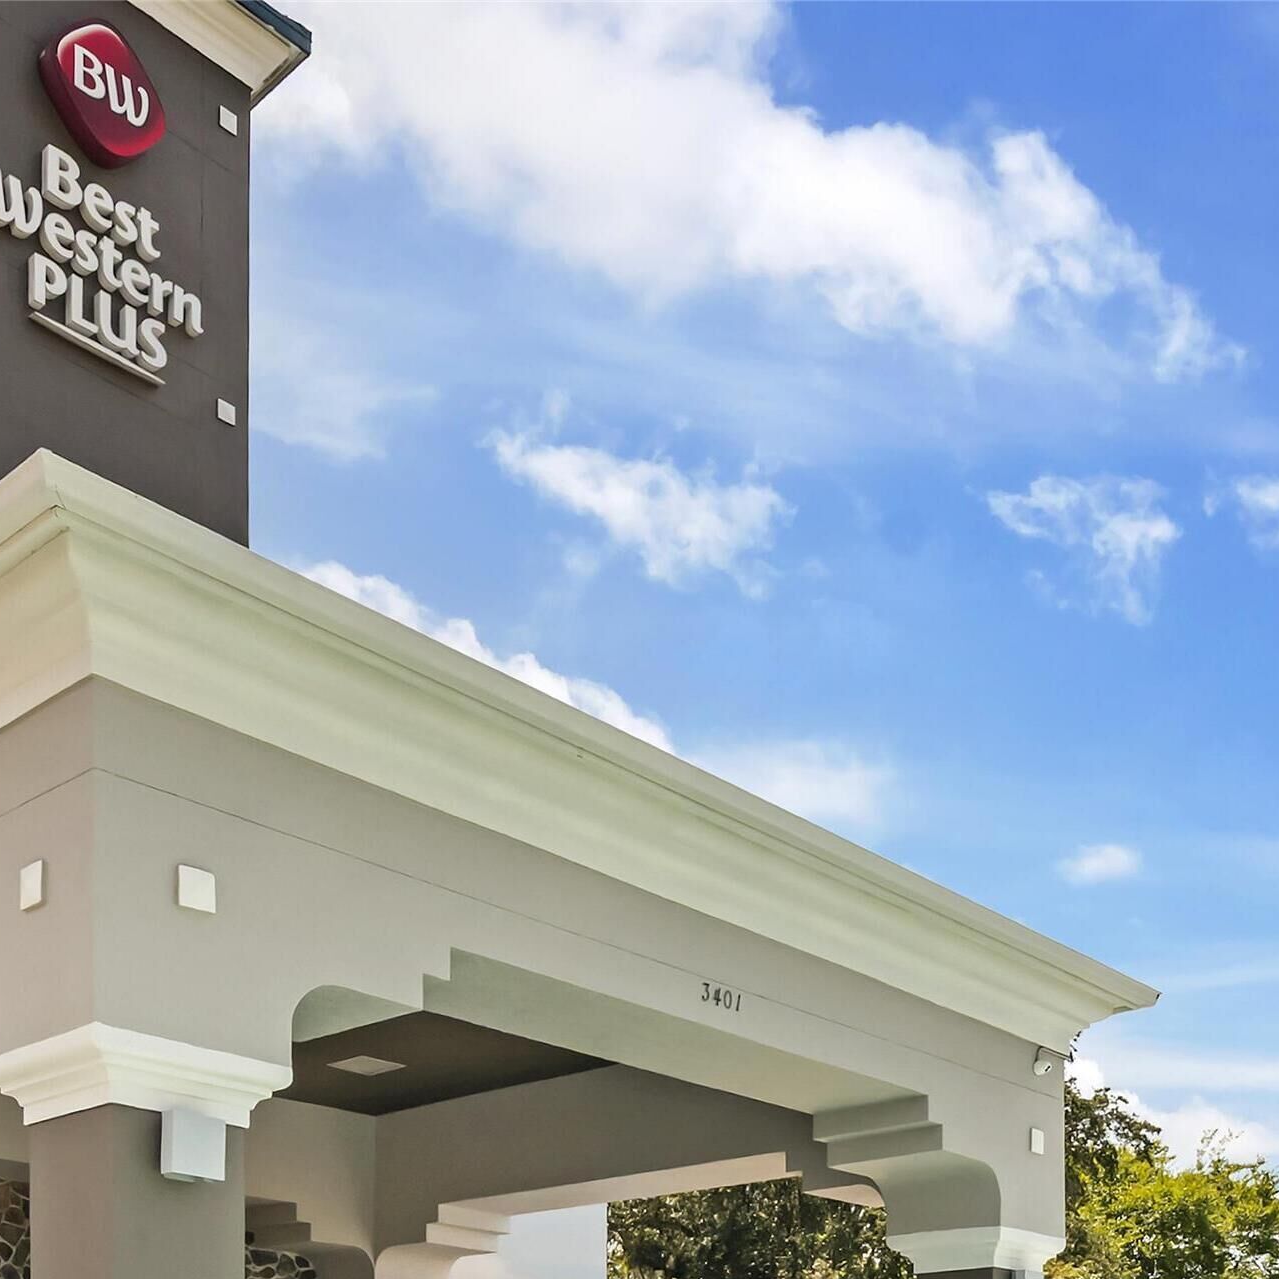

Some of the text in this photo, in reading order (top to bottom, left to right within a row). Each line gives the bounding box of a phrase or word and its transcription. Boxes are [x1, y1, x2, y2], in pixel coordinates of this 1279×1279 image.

[73, 42, 150, 128] BW
[41, 143, 161, 263] Best
[27, 252, 168, 373] PLUS
[701, 981, 741, 1012] 3401
